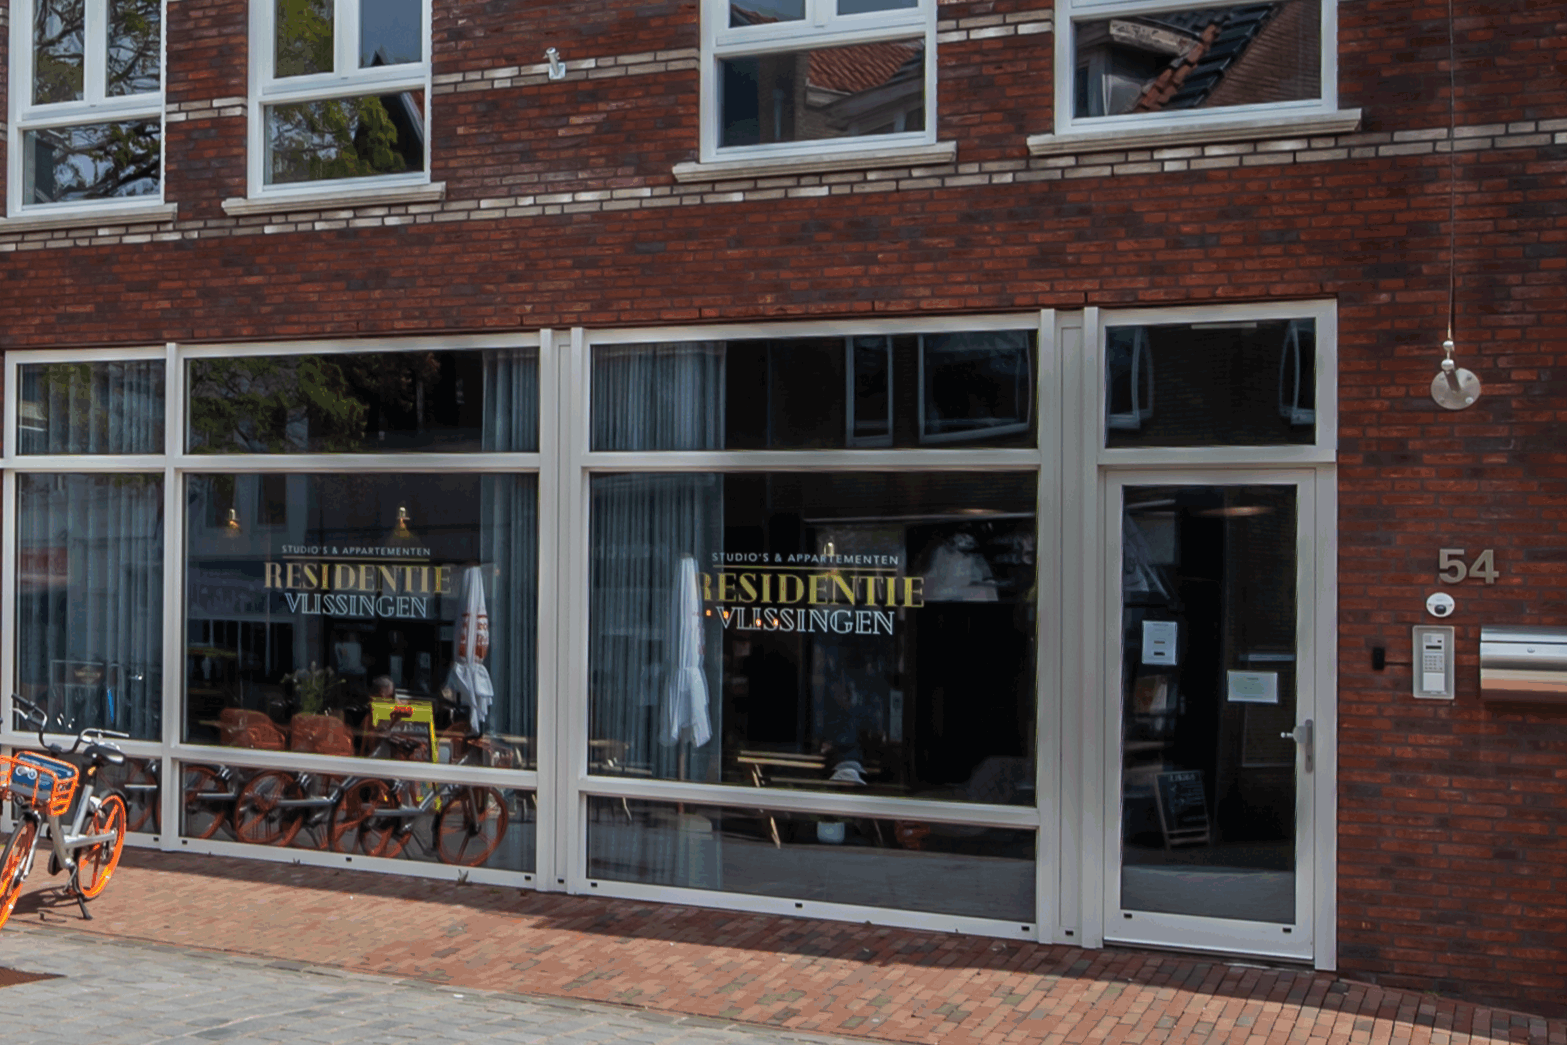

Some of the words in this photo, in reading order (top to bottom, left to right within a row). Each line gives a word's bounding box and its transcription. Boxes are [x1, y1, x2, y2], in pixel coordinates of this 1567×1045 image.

[282, 545, 328, 555] STUDIO'S
[332, 546, 338, 555] &
[342, 546, 431, 556] APPARTEMENTEN
[712, 552, 769, 563] STUDIO'S
[774, 553, 782, 563] &
[787, 553, 899, 565] APPARTEMENTEN
[264, 562, 452, 595] RESIDENTIE
[1439, 549, 1499, 584] 54
[284, 593, 428, 618] VLISSINGEN
[716, 606, 895, 635] VLISSINGEN
